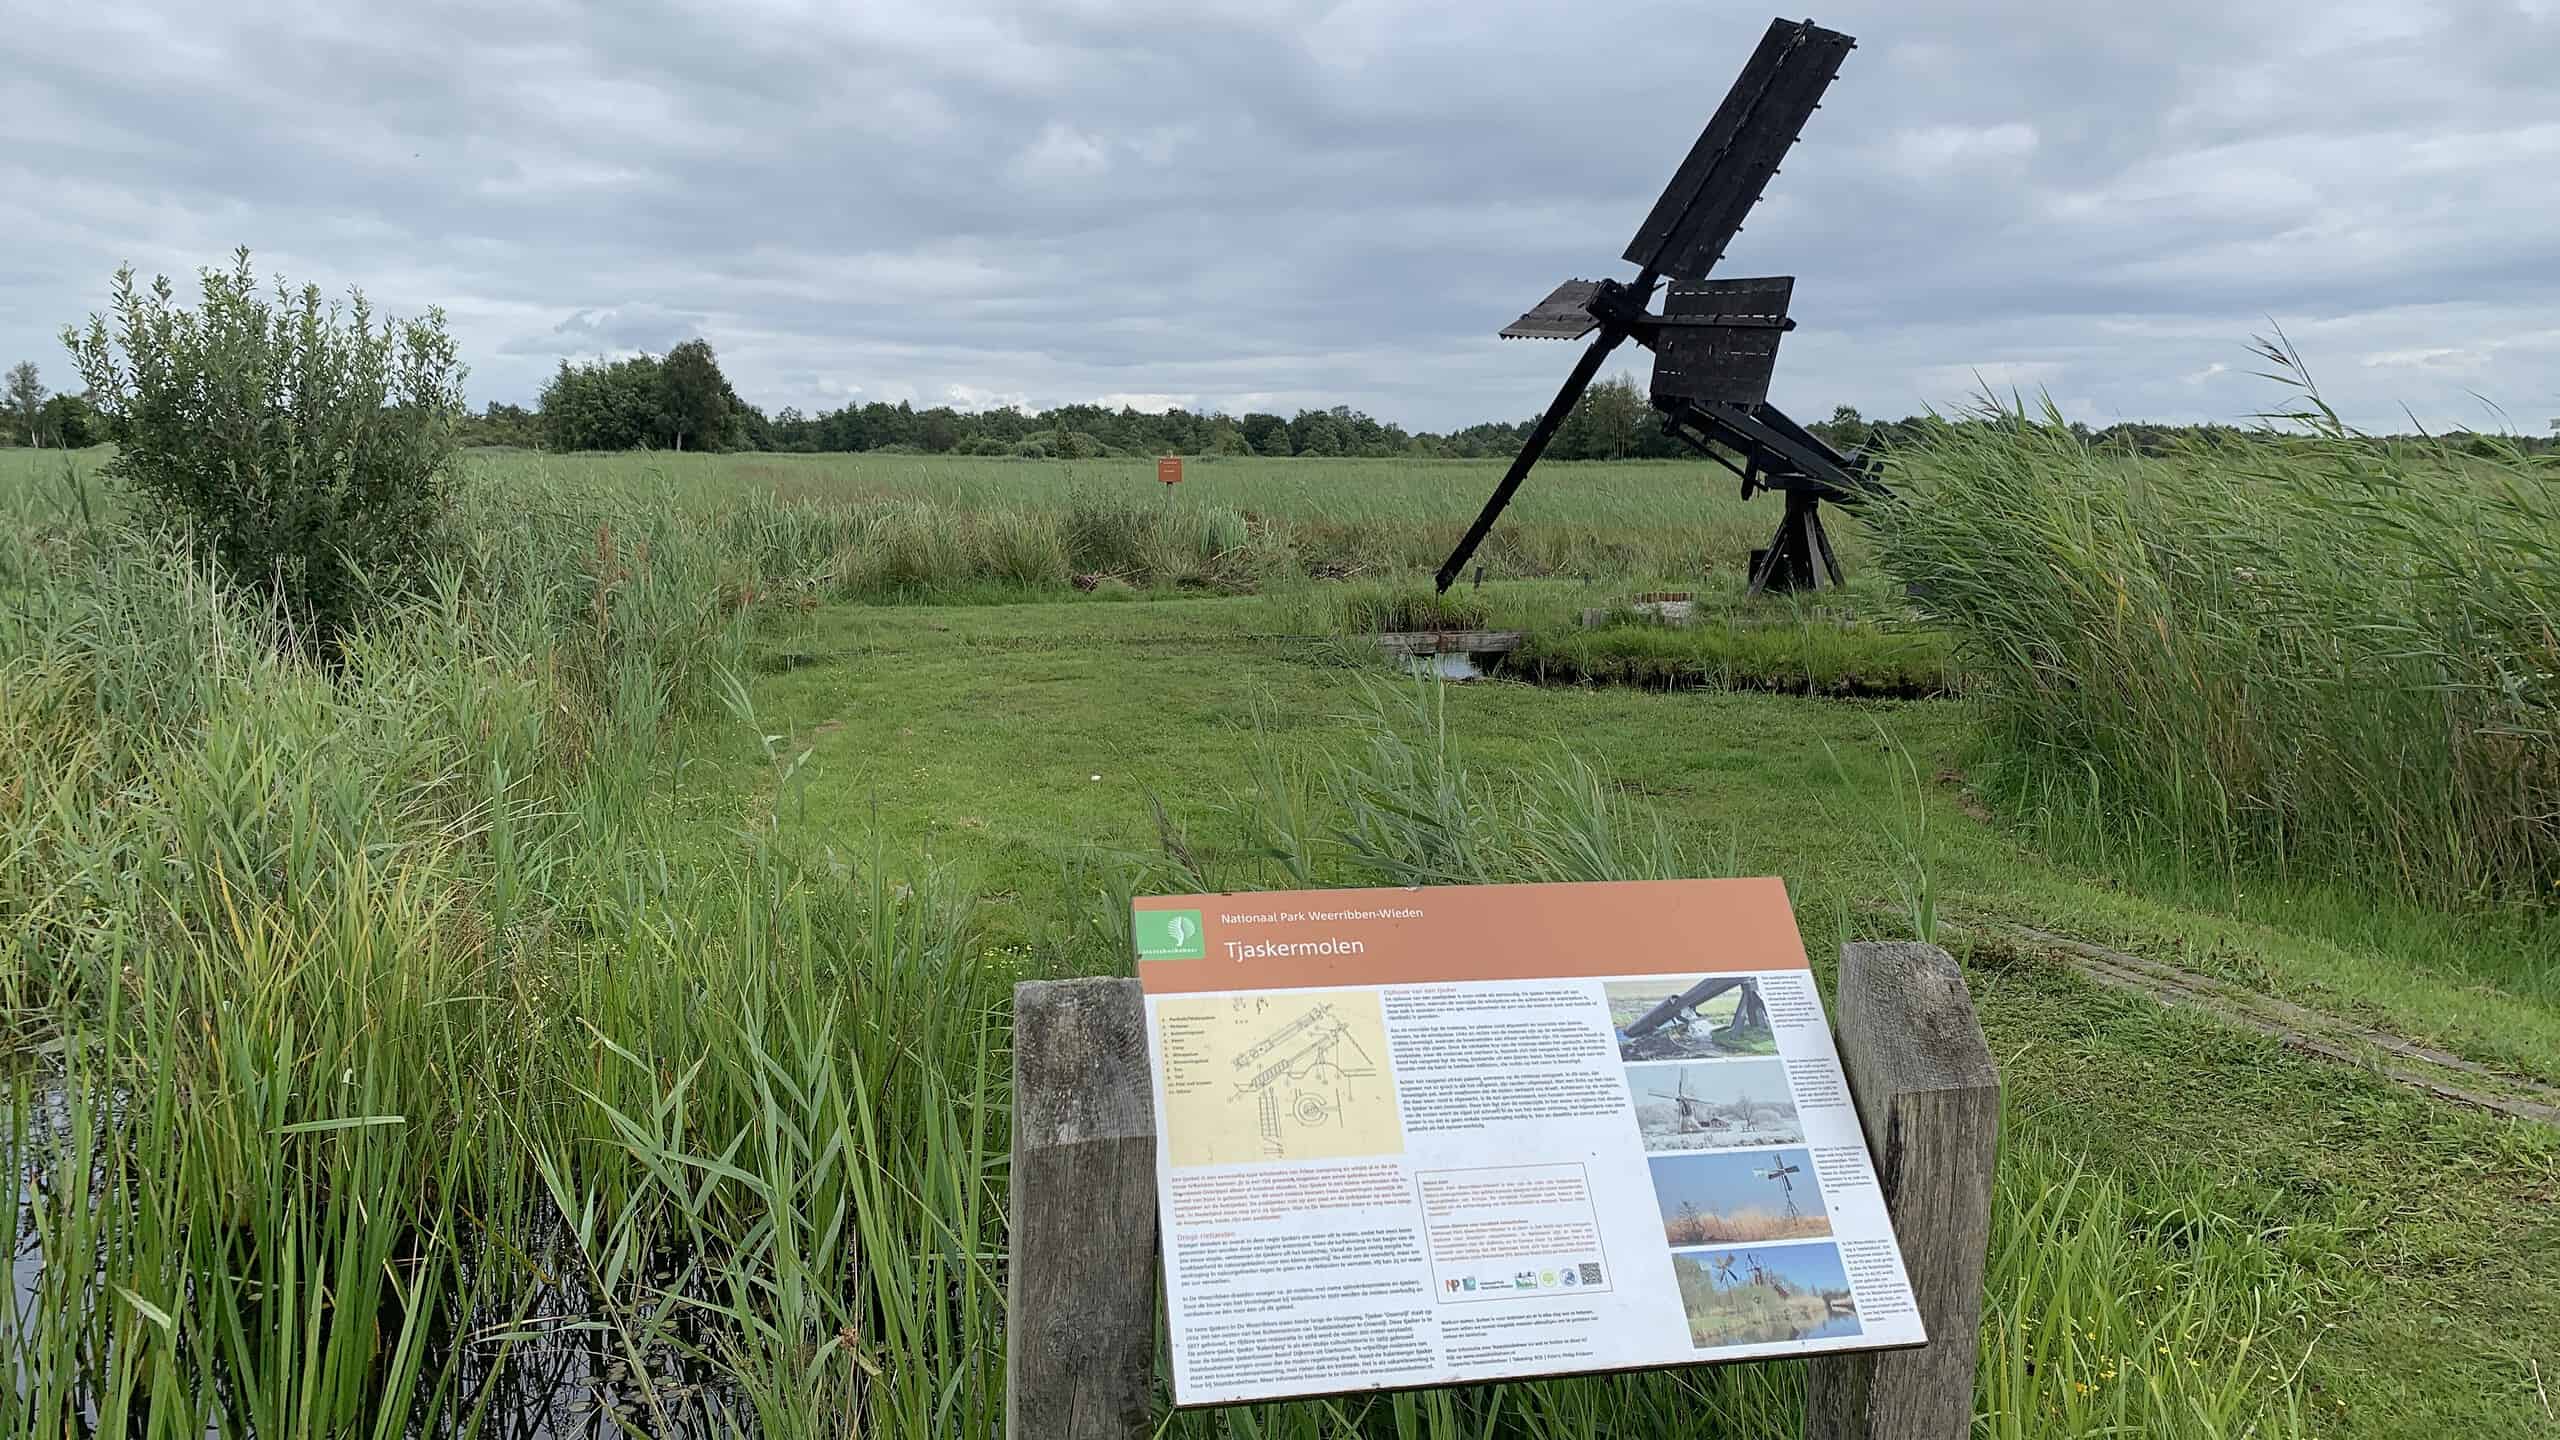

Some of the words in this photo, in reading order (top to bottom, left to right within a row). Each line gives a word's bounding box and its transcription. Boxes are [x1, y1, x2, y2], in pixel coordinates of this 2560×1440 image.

[1221, 911, 1278, 924] Nationaal
[1280, 911, 1306, 922] Park
[1309, 908, 1424, 921] Weerribben-Wieden
[1223, 937, 1364, 962] Tjaskermolen
